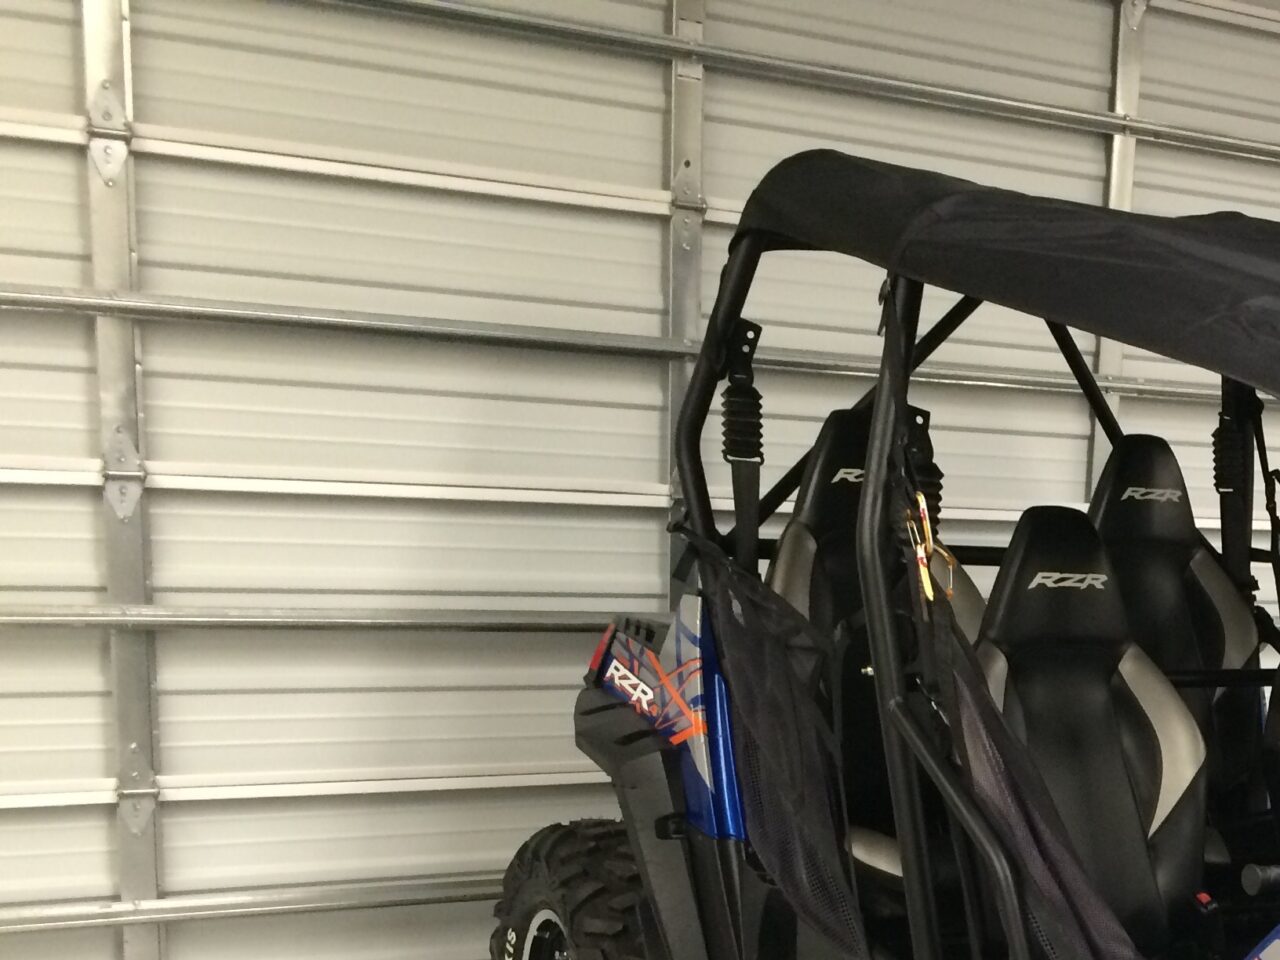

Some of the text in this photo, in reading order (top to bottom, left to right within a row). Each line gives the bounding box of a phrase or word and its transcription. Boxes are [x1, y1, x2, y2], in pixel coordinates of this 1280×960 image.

[1121, 487, 1182, 502] RZR
[1028, 572, 1109, 589] RZR
[604, 658, 654, 712] RZR
